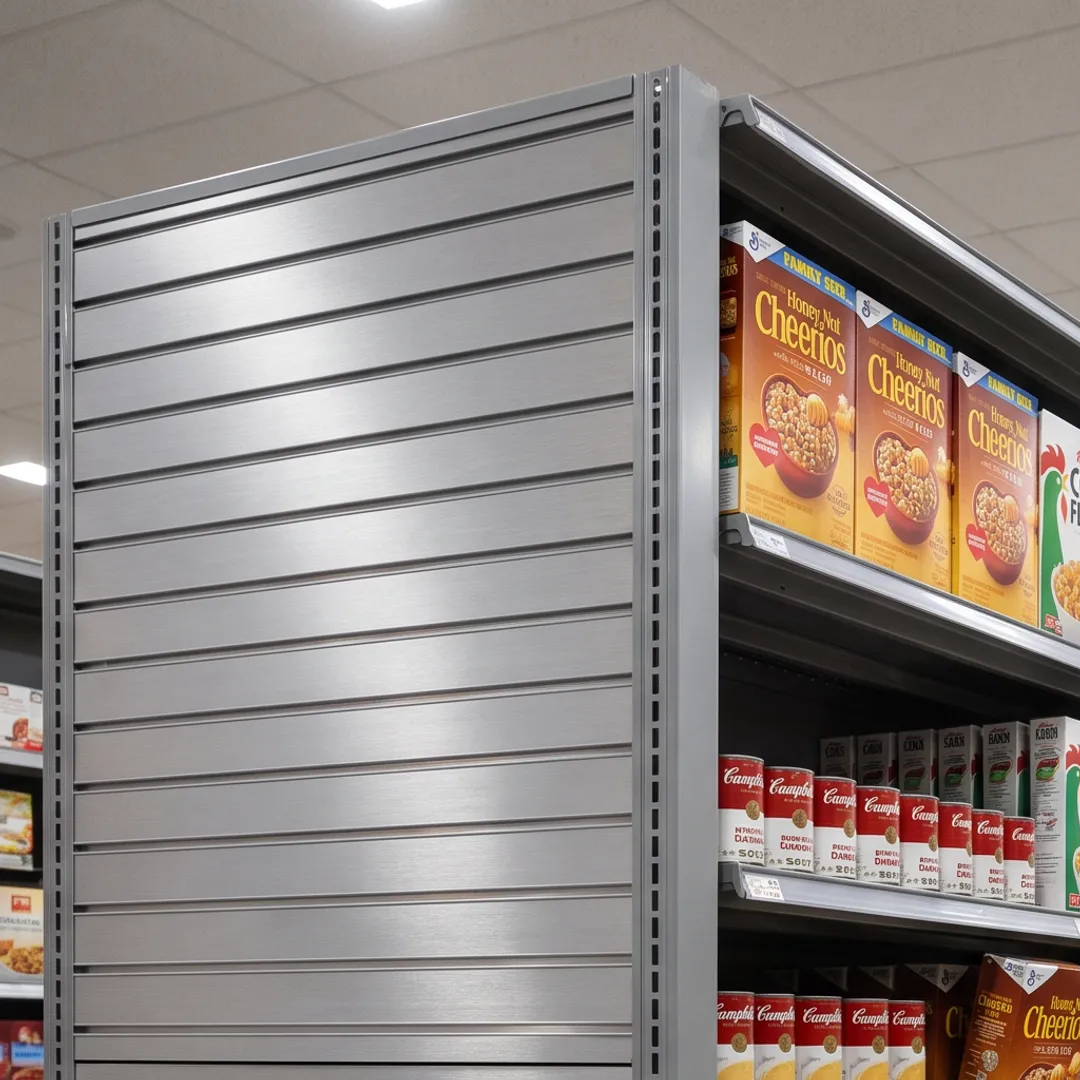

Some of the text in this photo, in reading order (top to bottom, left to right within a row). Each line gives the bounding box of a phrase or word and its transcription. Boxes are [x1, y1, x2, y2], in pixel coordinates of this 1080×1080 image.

[755, 290, 846, 375] Cheerios
[868, 354, 945, 428] Cheerios
[968, 409, 1033, 477] Cheerios
